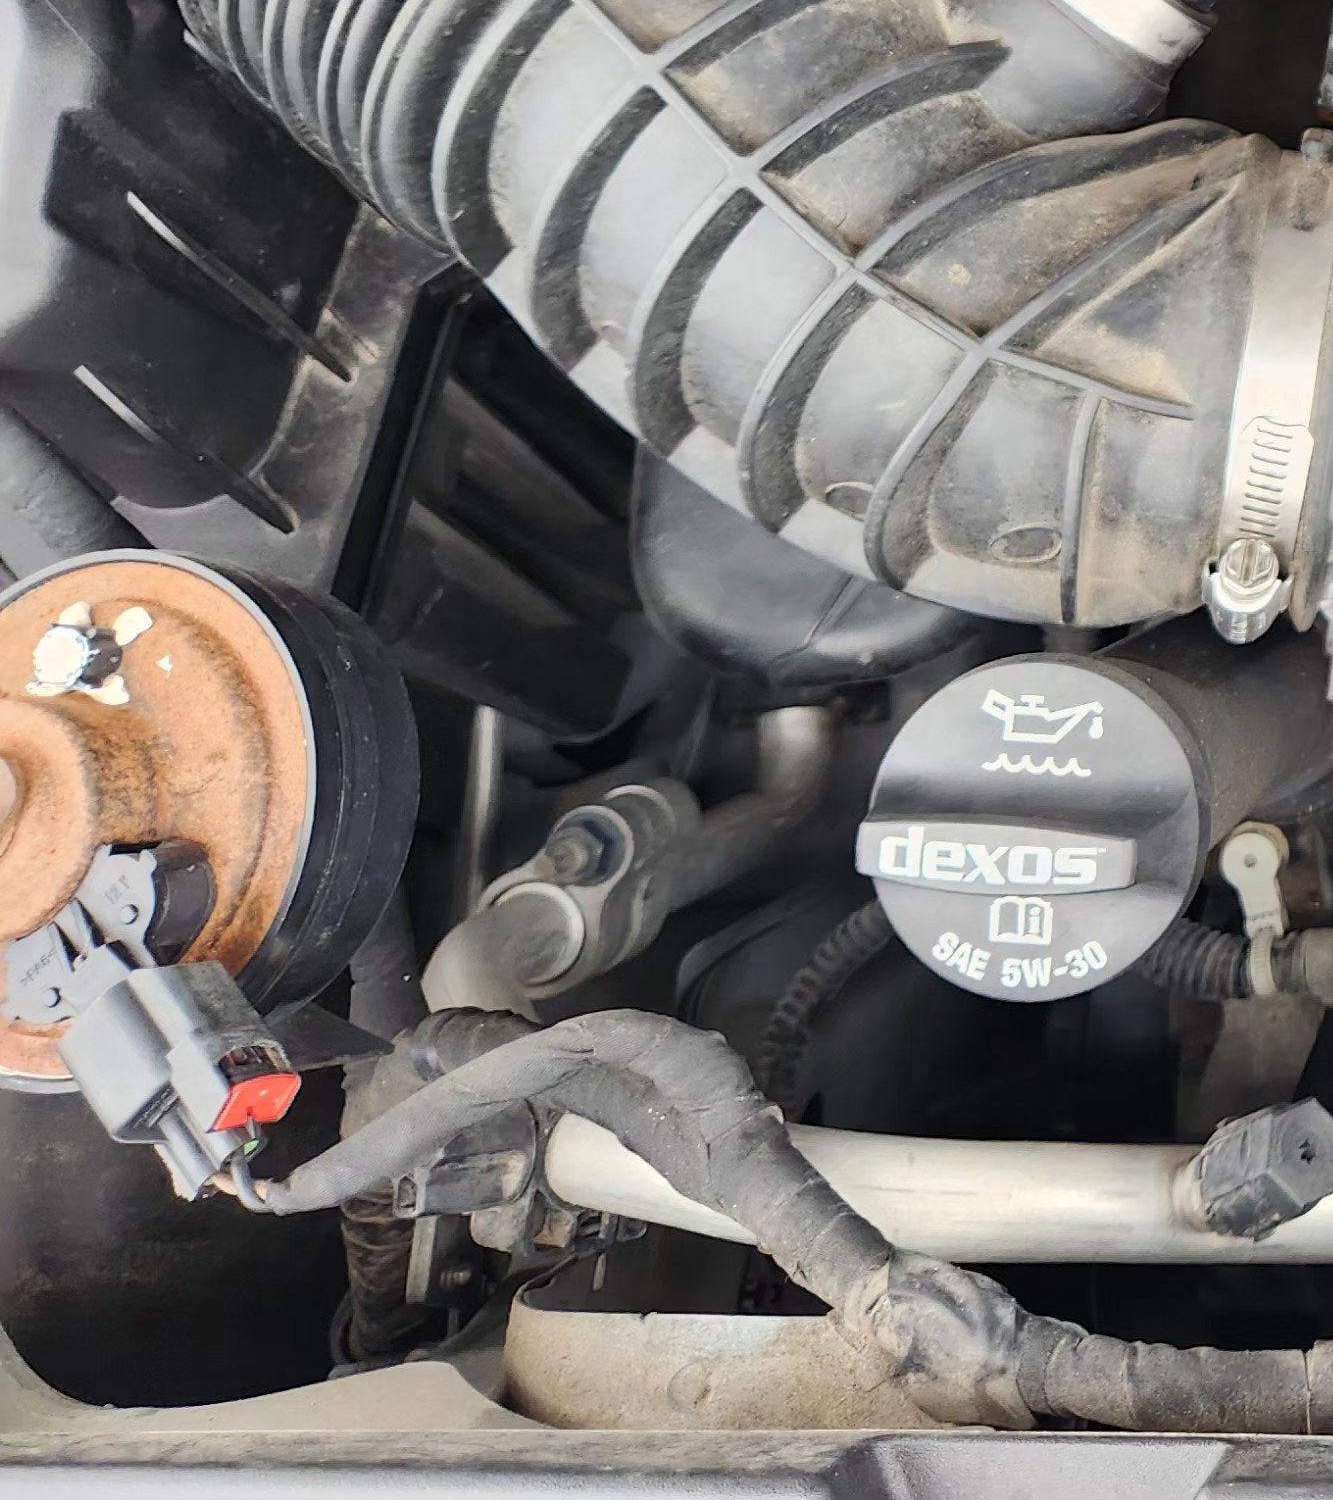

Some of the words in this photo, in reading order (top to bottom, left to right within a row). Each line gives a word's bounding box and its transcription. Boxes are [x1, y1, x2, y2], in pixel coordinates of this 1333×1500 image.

[878, 826, 1099, 886] dexos
[931, 931, 992, 981] SAE
[1000, 940, 1109, 988] 5W-30
